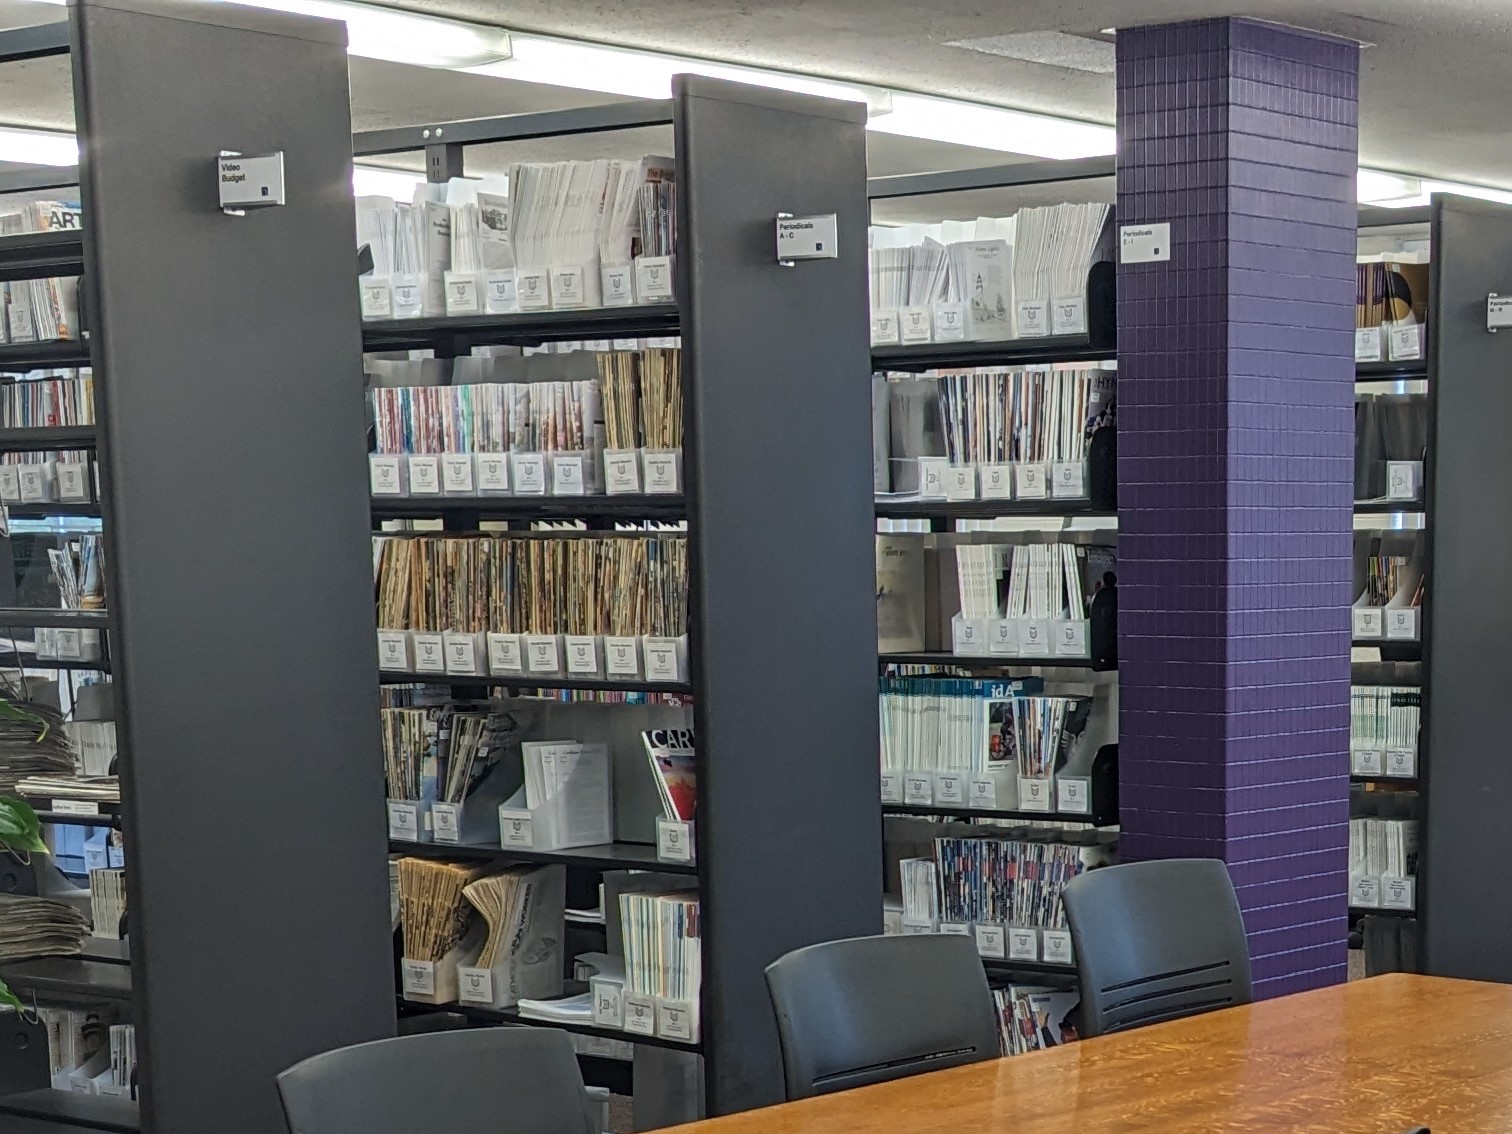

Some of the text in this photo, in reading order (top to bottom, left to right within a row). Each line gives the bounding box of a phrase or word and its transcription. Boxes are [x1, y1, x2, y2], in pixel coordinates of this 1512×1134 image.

[221, 164, 241, 172] Video
[222, 173, 246, 184] Budget
[651, 729, 695, 749] CAR
